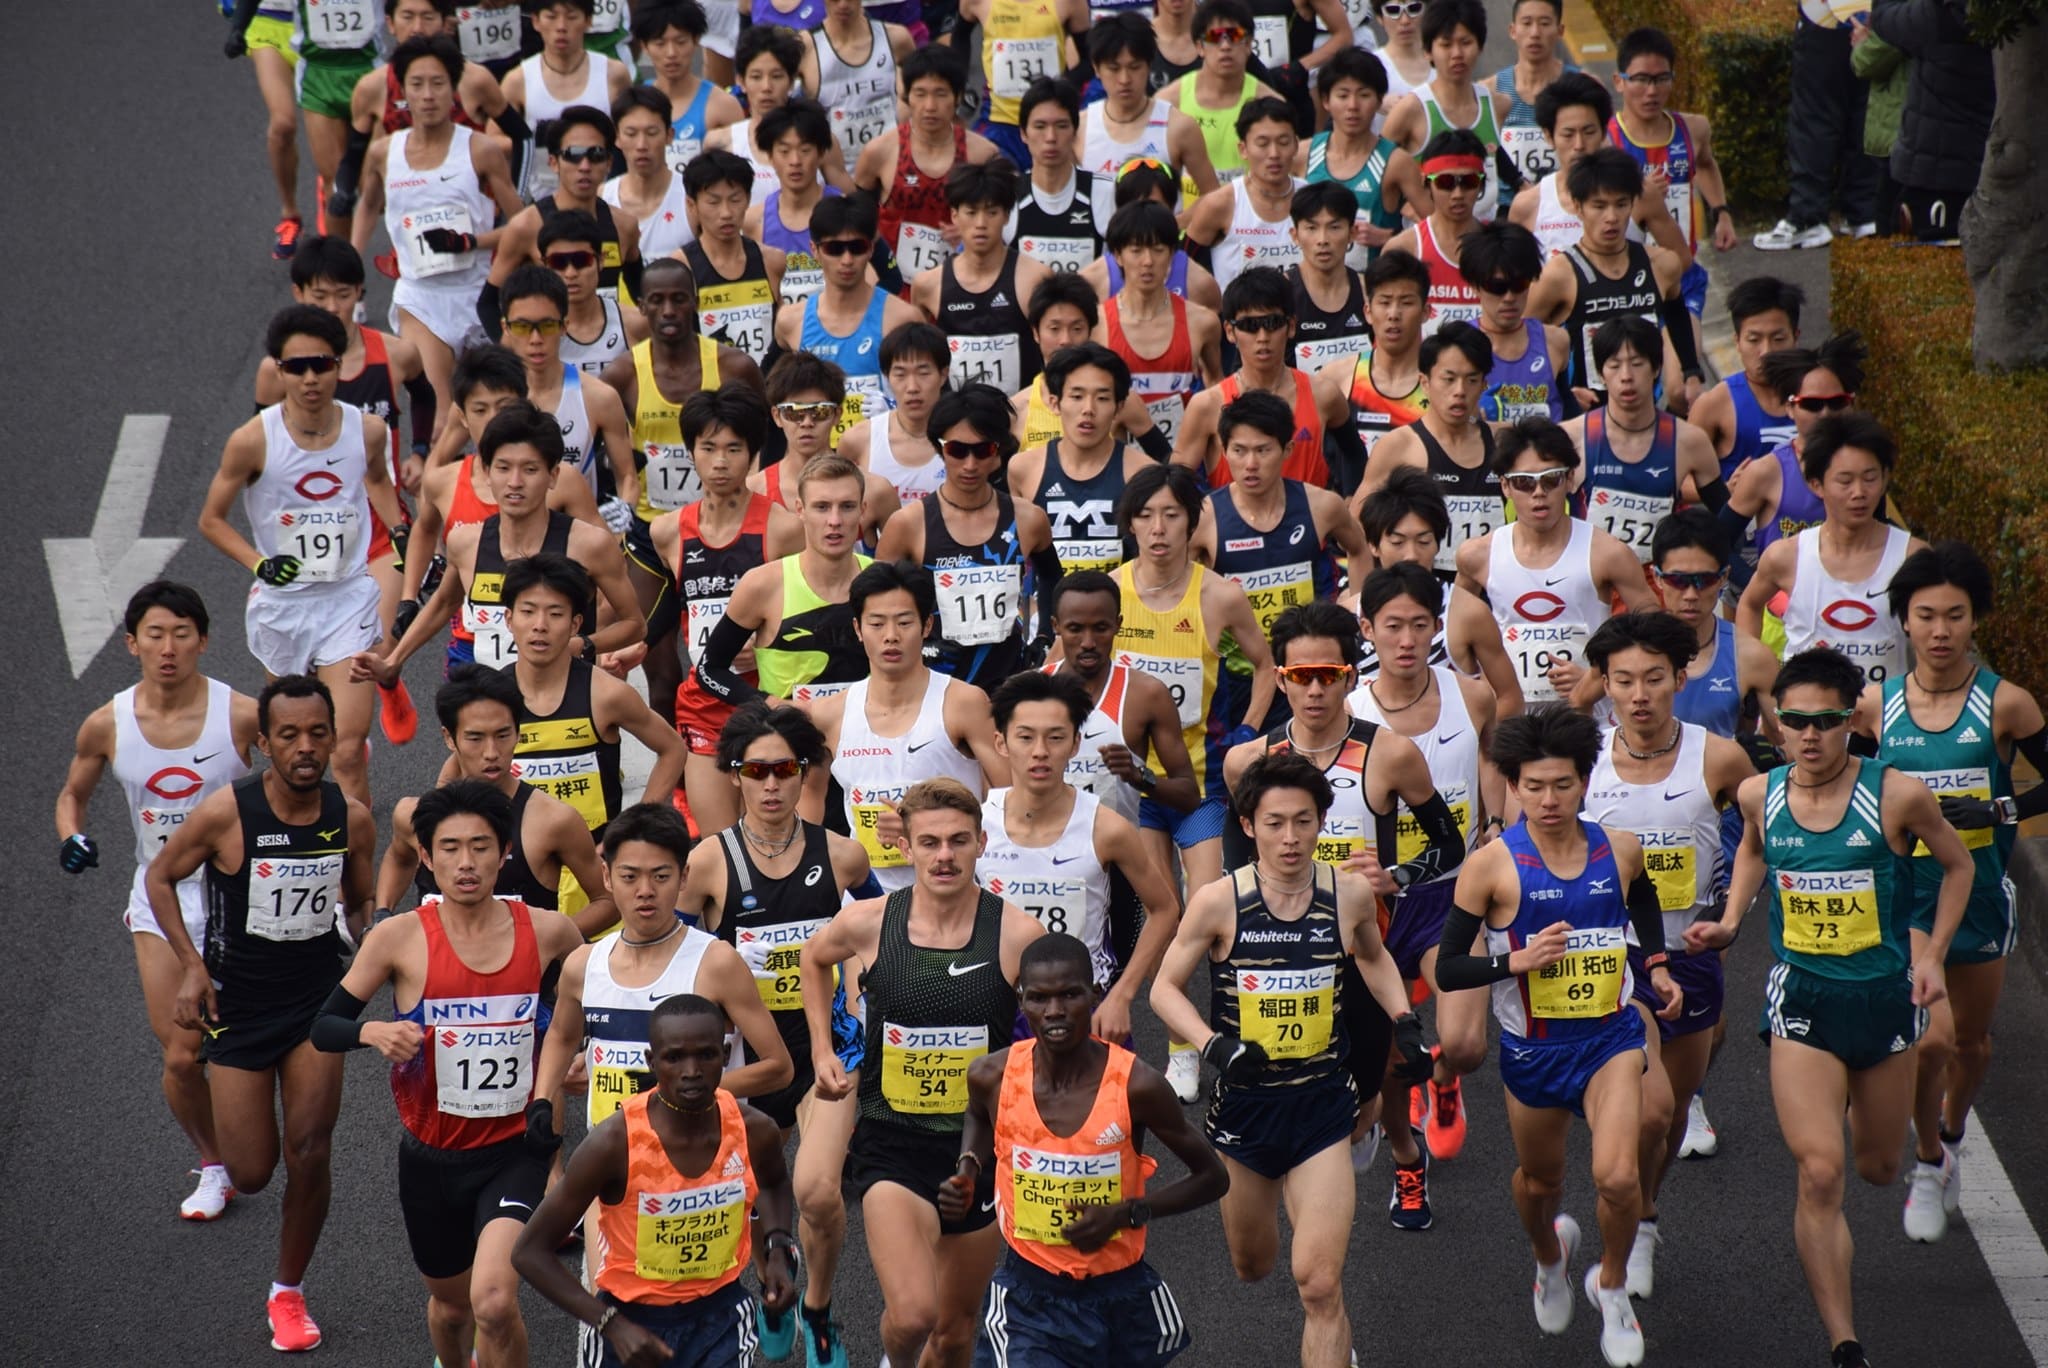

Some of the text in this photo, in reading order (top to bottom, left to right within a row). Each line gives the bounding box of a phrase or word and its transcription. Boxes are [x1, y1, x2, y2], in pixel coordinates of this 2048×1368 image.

[321, 11, 364, 32] 132
[473, 20, 513, 46] 196
[1008, 41, 1053, 51] クロスビー
[1005, 58, 1046, 80] 131
[844, 79, 885, 97] JFE
[845, 121, 886, 146] 167
[1511, 149, 1555, 171] 165
[389, 179, 428, 189] HONDA
[415, 207, 466, 226] クロスビー
[1236, 228, 1277, 236] HONDA
[1540, 221, 1582, 231] HONDA
[1037, 241, 1091, 253] クロスビー
[1428, 286, 1460, 299] ASIA
[948, 302, 975, 312] GMO
[1585, 291, 1655, 314] コニカミノルタ
[719, 308, 770, 324] クロスビー
[1301, 321, 1327, 330] GMO
[962, 335, 1016, 352] クロスビー
[1315, 340, 1368, 355] クロスビー
[959, 358, 1003, 383] 111
[659, 467, 703, 491] 17
[1611, 495, 1670, 513] クロスビー
[298, 512, 356, 526] クロスビー
[1604, 515, 1655, 544] 152
[296, 534, 345, 559] 191
[1057, 544, 1119, 558] クロスビー
[1228, 540, 1262, 550] Yakult
[935, 554, 973, 567] TOENEC
[957, 569, 1017, 586] クロスビー
[1246, 569, 1308, 588] クロスビー
[700, 603, 730, 618] クロ
[954, 591, 1006, 623] 116
[1521, 627, 1585, 642] クロスビー
[1833, 640, 1895, 657] クロスビー
[1135, 659, 1200, 674] クロスビー
[842, 747, 892, 758] HONDA
[525, 760, 593, 778] クロスビー
[555, 778, 590, 800] 祥平
[1922, 774, 1985, 790] ロスビー
[158, 812, 190, 825] クロ
[257, 834, 291, 846] SEISA
[277, 862, 340, 878] クロスビー
[1008, 880, 1081, 897] クロスビー
[1796, 875, 1870, 891] クロスビー
[270, 885, 328, 917] 176
[1529, 889, 1563, 900] 中国電力
[1789, 895, 1865, 917] 鈴木 塁人
[1239, 929, 1302, 943] Nishitetsu
[1813, 922, 1839, 939] 73
[1583, 955, 1618, 976] 拓也
[775, 975, 801, 993] 62
[1263, 972, 1333, 991] クロスビー
[1567, 982, 1594, 1000] 69
[432, 1002, 488, 1019] NTN
[1258, 998, 1297, 1019] 福田
[462, 1029, 533, 1048] クロスビー
[906, 1031, 985, 1048] クロスビー
[1277, 1023, 1303, 1042] 70
[606, 1048, 648, 1065] クロス
[904, 1052, 964, 1064] ライナー
[457, 1057, 519, 1091] 123
[903, 1065, 966, 1080] Rayner
[596, 1070, 624, 1095] 村山
[919, 1079, 948, 1097] 54
[1037, 1156, 1117, 1176] クロスビー
[1014, 1173, 1119, 1194] チェルイヨット
[667, 1186, 742, 1214] クロスビー
[655, 1210, 730, 1232] キプラガト
[655, 1223, 730, 1246] Kiplagat
[679, 1243, 708, 1264] 52
